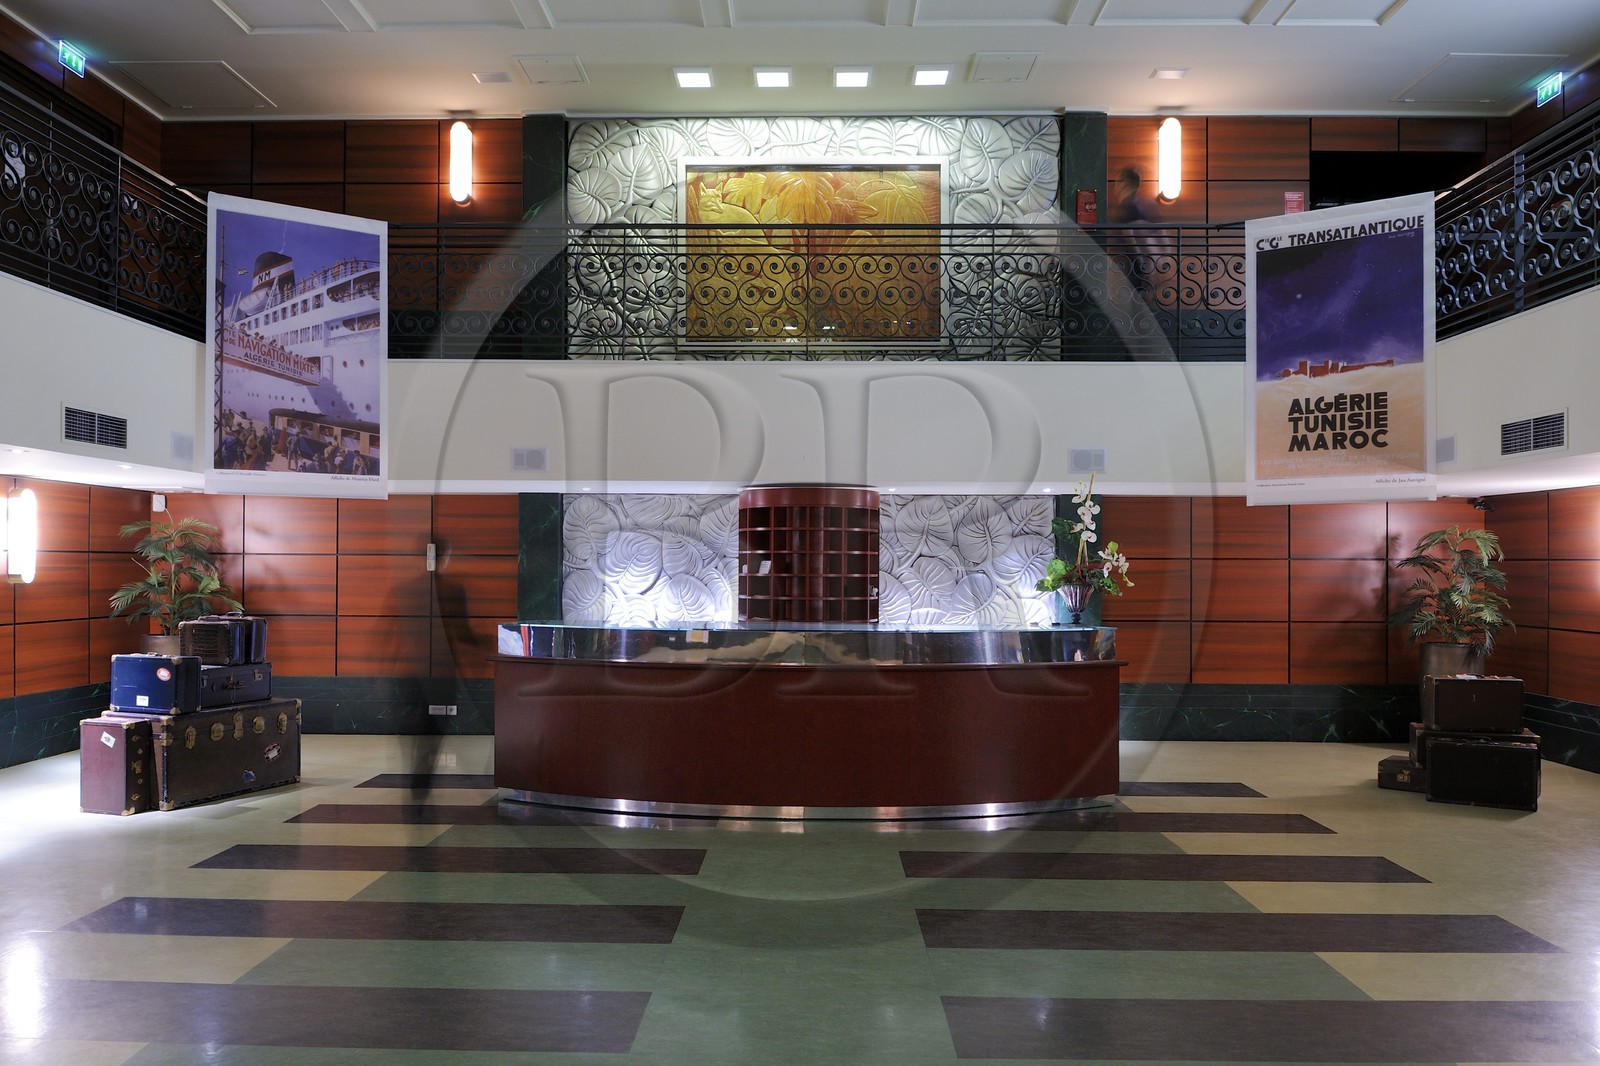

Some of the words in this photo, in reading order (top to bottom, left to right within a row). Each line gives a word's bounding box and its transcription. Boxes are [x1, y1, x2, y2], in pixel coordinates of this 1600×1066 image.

[1288, 215, 1425, 247] TRANSATLANTIQUE
[257, 270, 271, 284] NM
[238, 335, 291, 366] NAVIGATION
[293, 357, 315, 376] MIXTE
[277, 363, 303, 377] TUNISIE
[1288, 391, 1388, 417] ALGÉRIE
[1288, 410, 1388, 434] TUNISIE
[1288, 428, 1389, 453] MAROC
